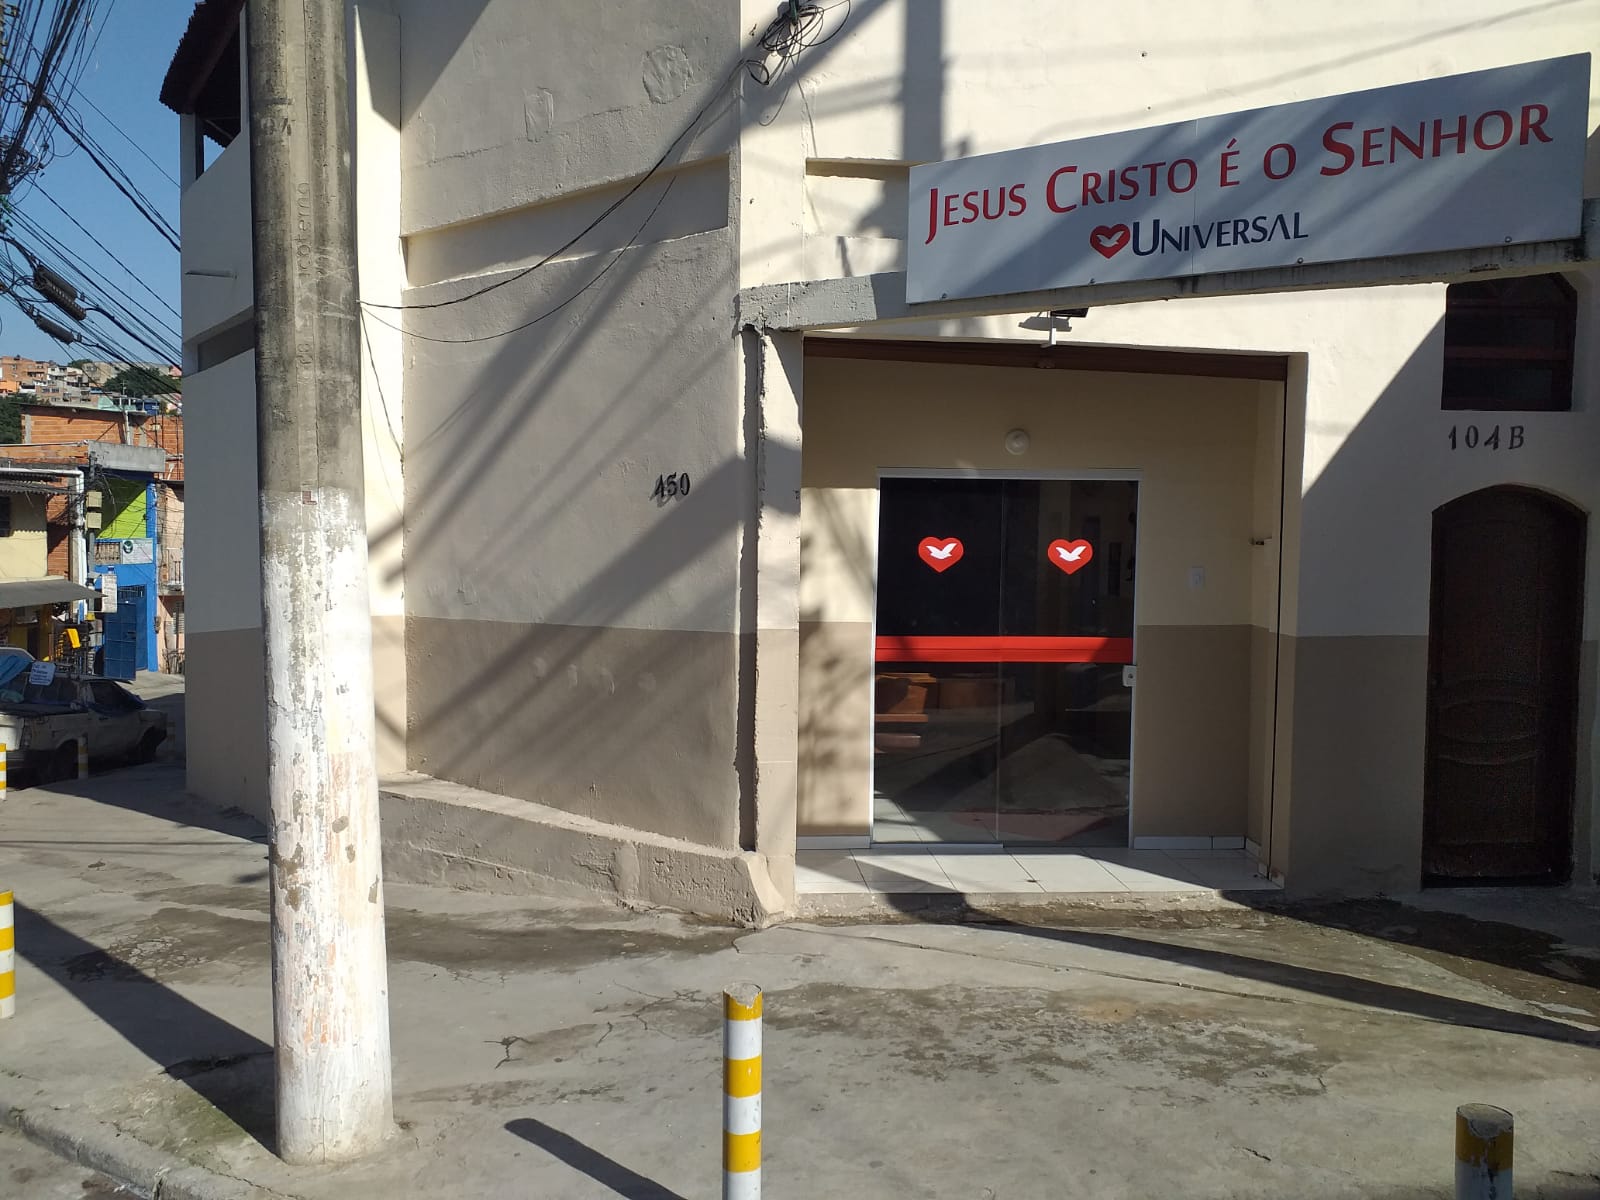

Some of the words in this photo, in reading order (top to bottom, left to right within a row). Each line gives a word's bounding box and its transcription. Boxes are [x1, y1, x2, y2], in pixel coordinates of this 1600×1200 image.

[925, 183, 1027, 245] JESUS
[1046, 158, 1198, 214] CRISTO
[1220, 138, 1240, 187] É
[1263, 143, 1297, 181] O
[1320, 103, 1554, 176] SENHOR
[1132, 211, 1309, 256] UNIVERSAL
[654, 472, 691, 498] 450
